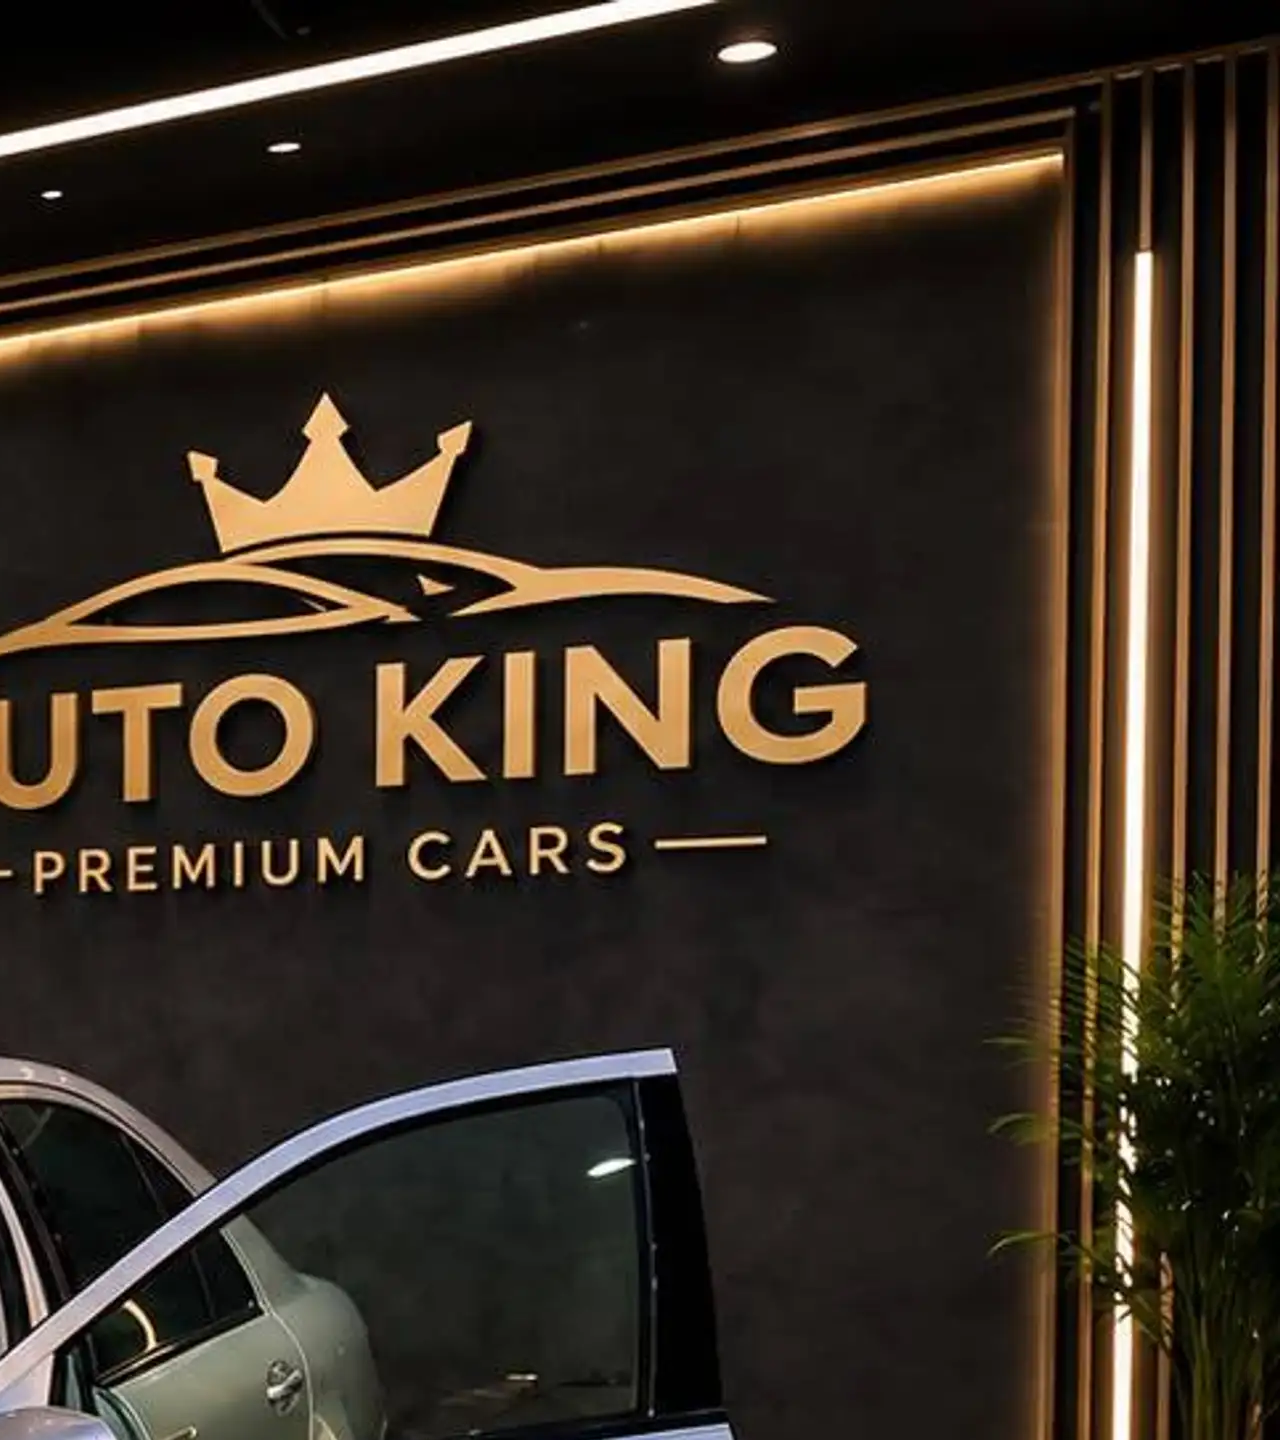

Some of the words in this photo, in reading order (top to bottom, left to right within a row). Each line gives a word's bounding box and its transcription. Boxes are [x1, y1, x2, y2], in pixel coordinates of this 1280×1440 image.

[376, 625, 866, 787] KING
[33, 835, 365, 895] PREMIUM
[408, 822, 627, 880] CARS
